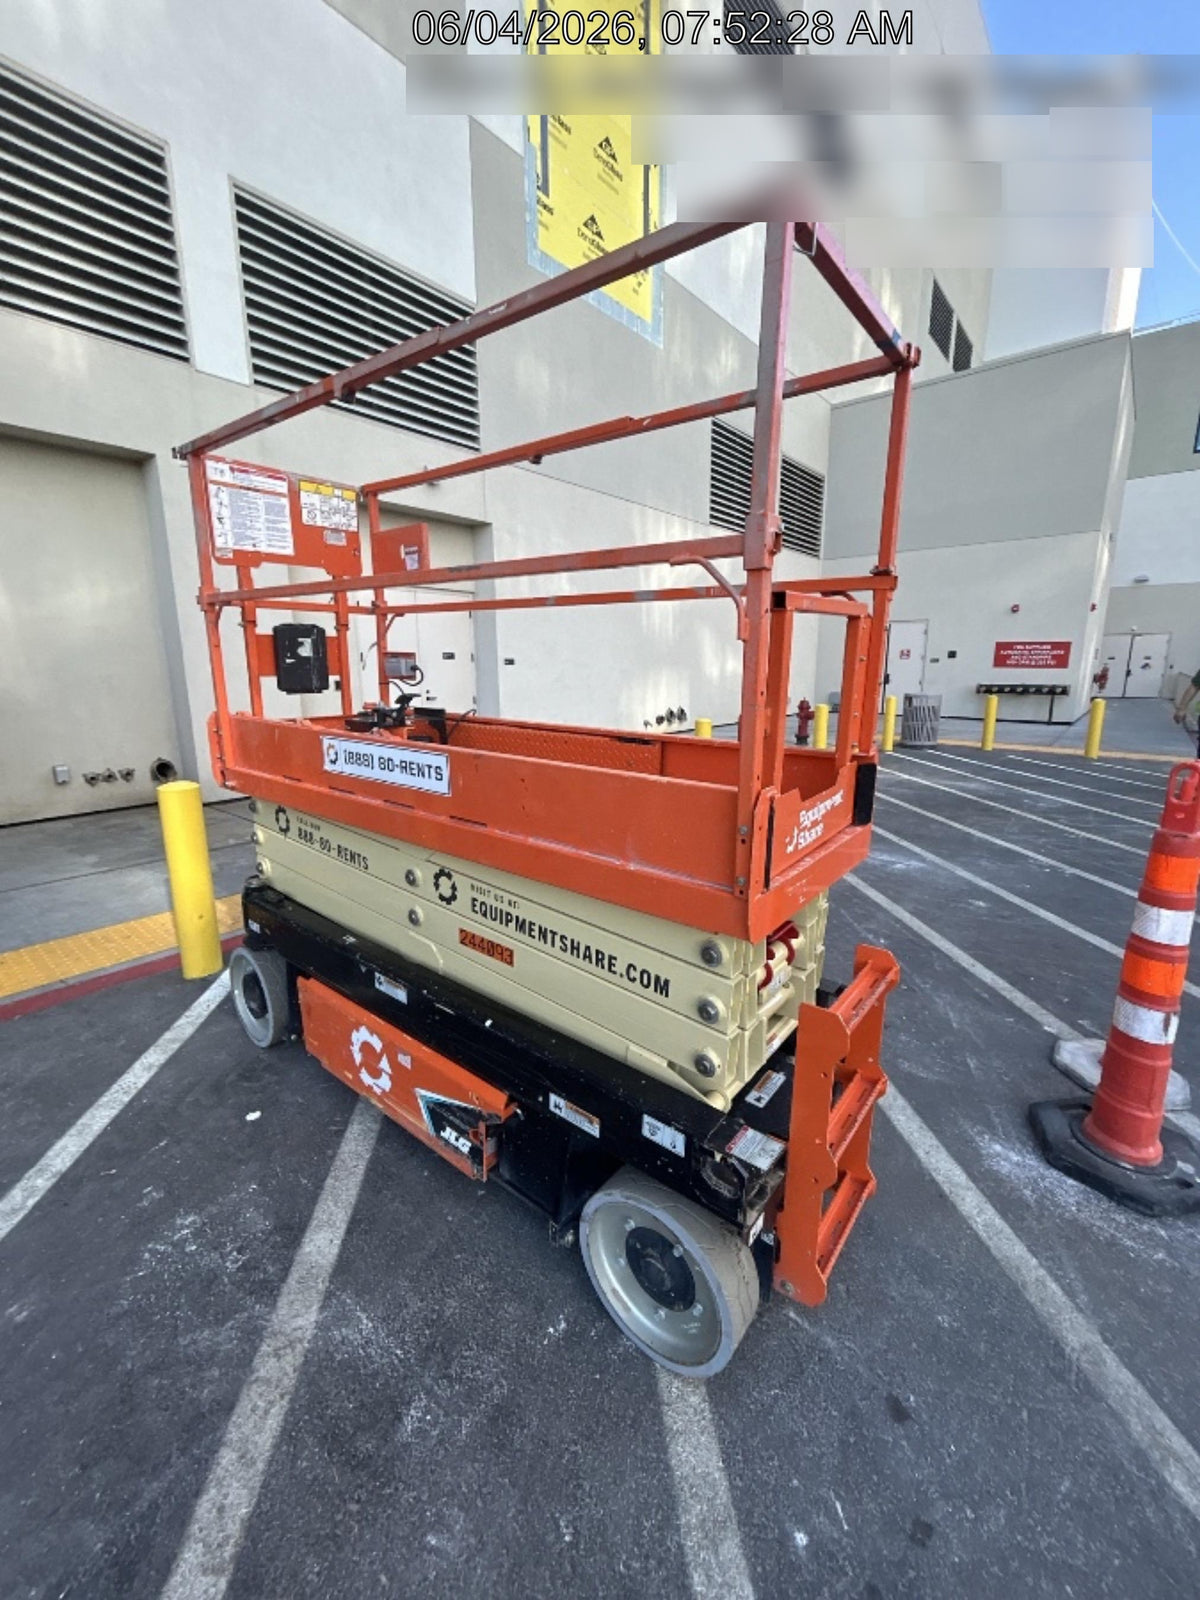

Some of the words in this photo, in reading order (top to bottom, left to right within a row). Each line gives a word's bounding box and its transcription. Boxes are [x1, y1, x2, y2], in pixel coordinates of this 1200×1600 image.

[344, 750, 374, 770] (888)
[378, 757, 443, 781] 80-RENTS
[298, 826, 368, 870] 888-80-RENTS
[460, 929, 513, 966] 244093
[471, 897, 670, 998] EQUIPMENTSHARE.COM
[440, 1126, 472, 1154] JLG
